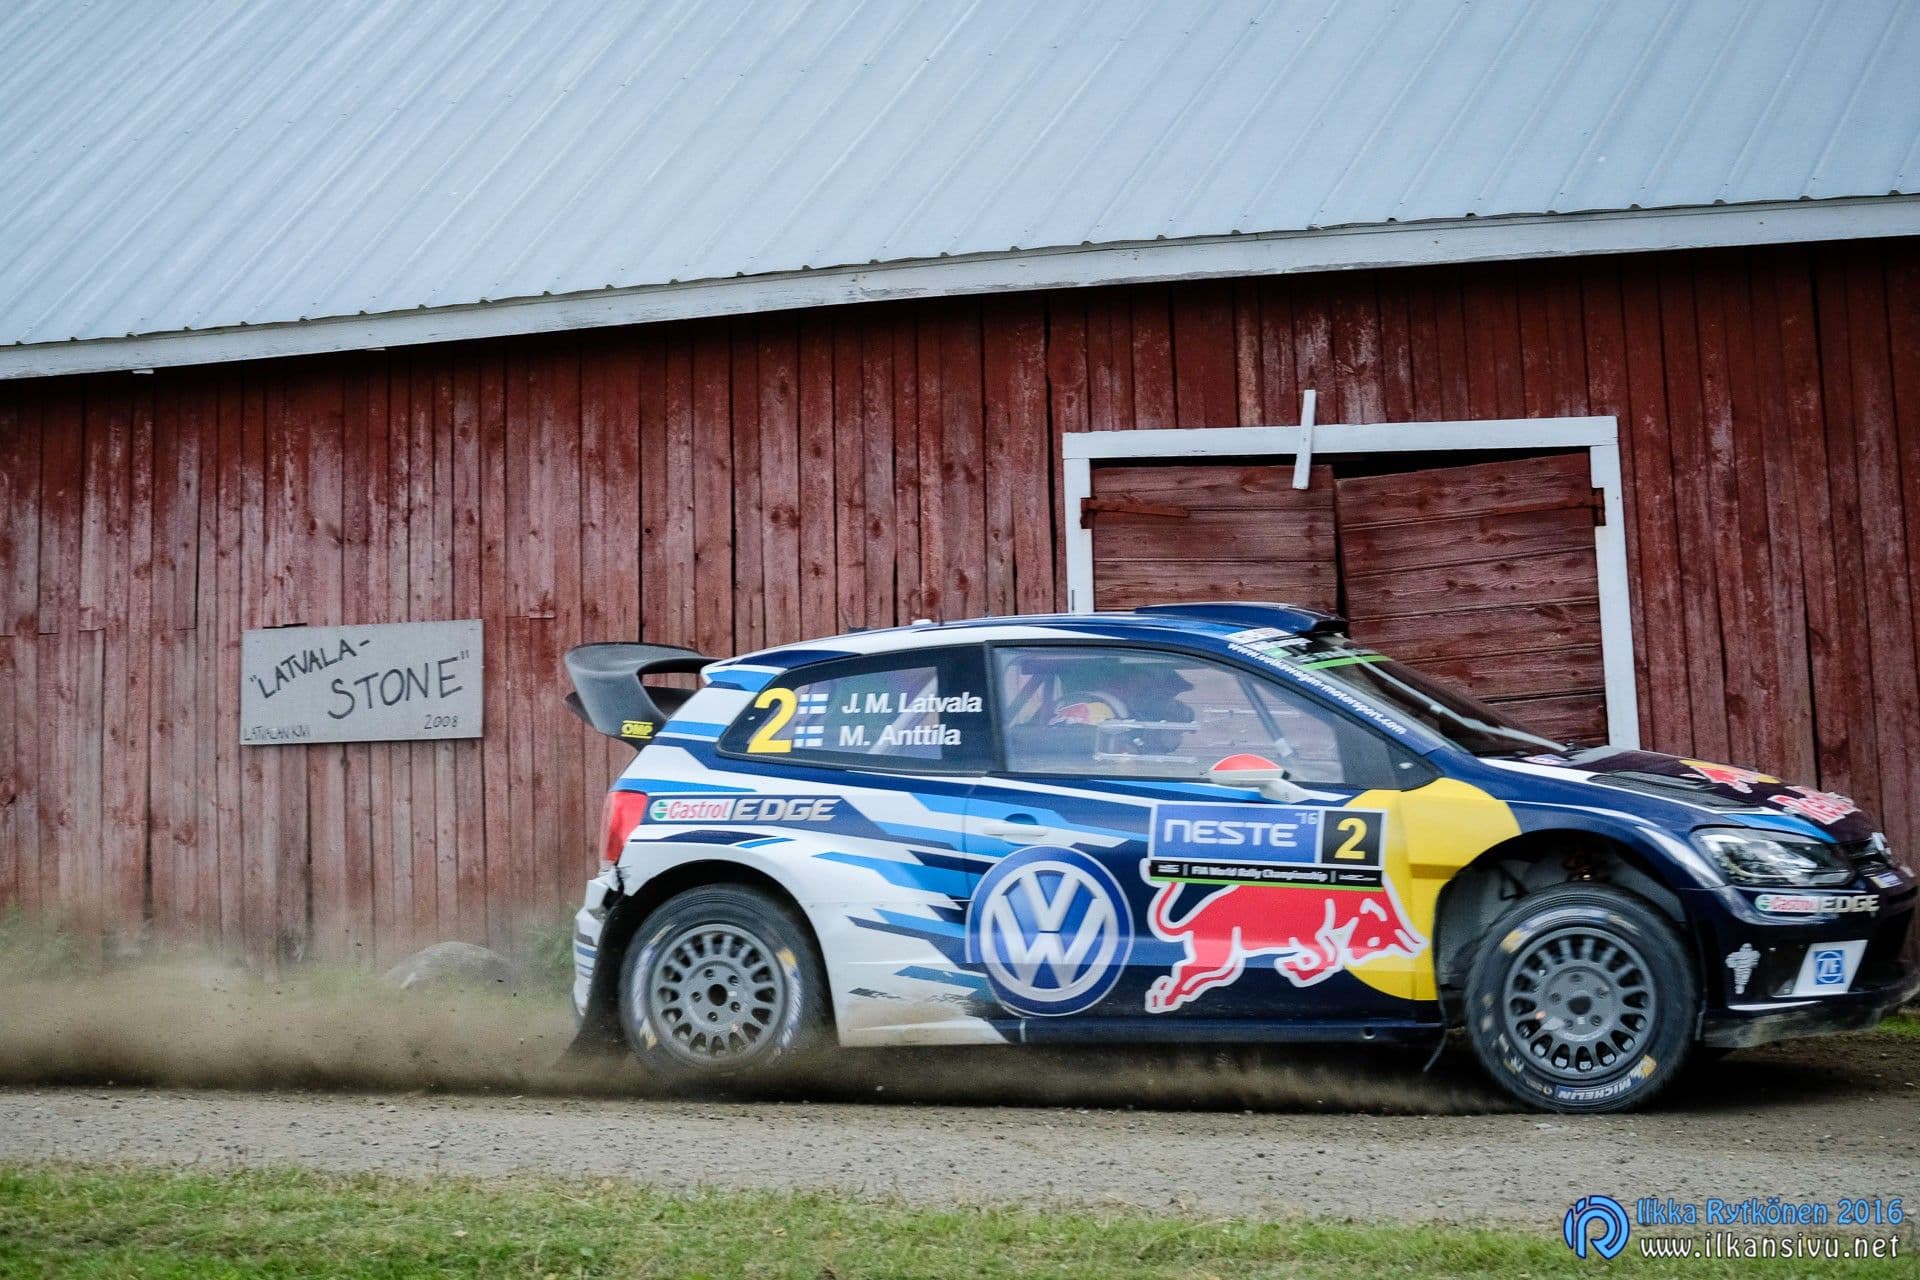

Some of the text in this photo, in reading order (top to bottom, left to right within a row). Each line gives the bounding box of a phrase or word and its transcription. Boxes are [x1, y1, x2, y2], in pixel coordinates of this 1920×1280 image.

[842, 692, 982, 714] J. M. Latvala
[423, 714, 459, 730] 2008
[747, 687, 798, 753] 2
[838, 724, 961, 747] M. Anttila
[667, 799, 843, 821] Castrol EDGE
[1163, 818, 1299, 848] NESTE
[1334, 817, 1368, 860] 2
[1209, 866, 1237, 877] World
[1237, 868, 1262, 880] Rally
[1820, 895, 1881, 913] EDGE
[1557, 1077, 1632, 1101] MICHELIN
